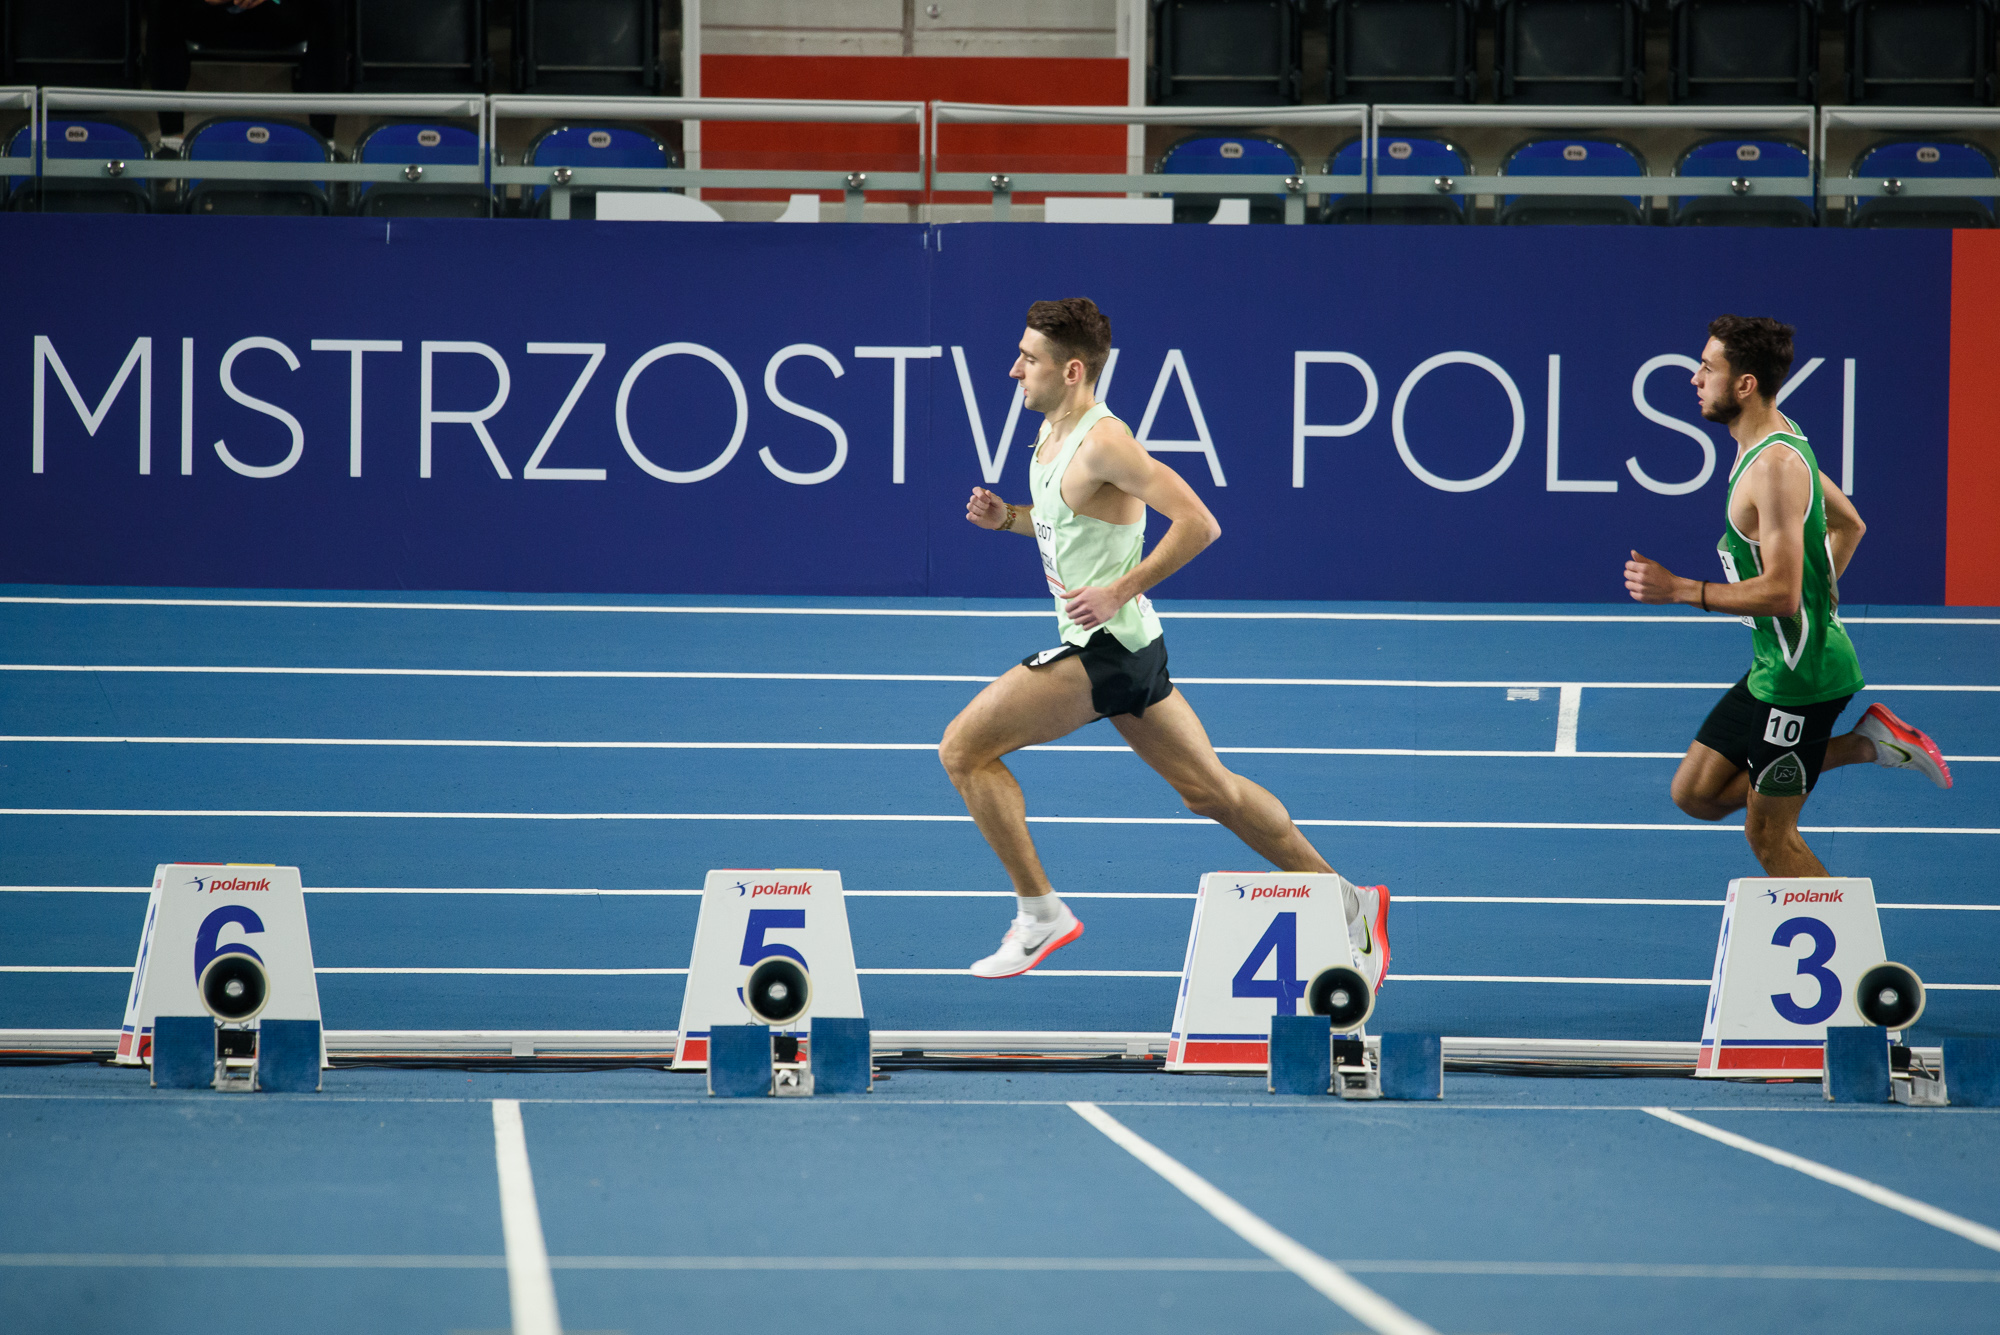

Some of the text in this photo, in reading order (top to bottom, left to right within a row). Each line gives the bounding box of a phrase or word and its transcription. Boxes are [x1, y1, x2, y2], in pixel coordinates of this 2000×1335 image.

[32, 335, 1856, 496] MISTRZOSTWA POLSI
[1036, 522, 1052, 541] 207
[1769, 715, 1801, 743] 10
[209, 877, 271, 894] polanik
[751, 881, 812, 898] polanik
[1250, 884, 1311, 901] polanik
[1783, 889, 1844, 906] polanik
[194, 904, 265, 990] 6
[736, 909, 810, 1008] 5
[1232, 911, 1309, 1016] 4
[1770, 916, 1843, 1026] 3
